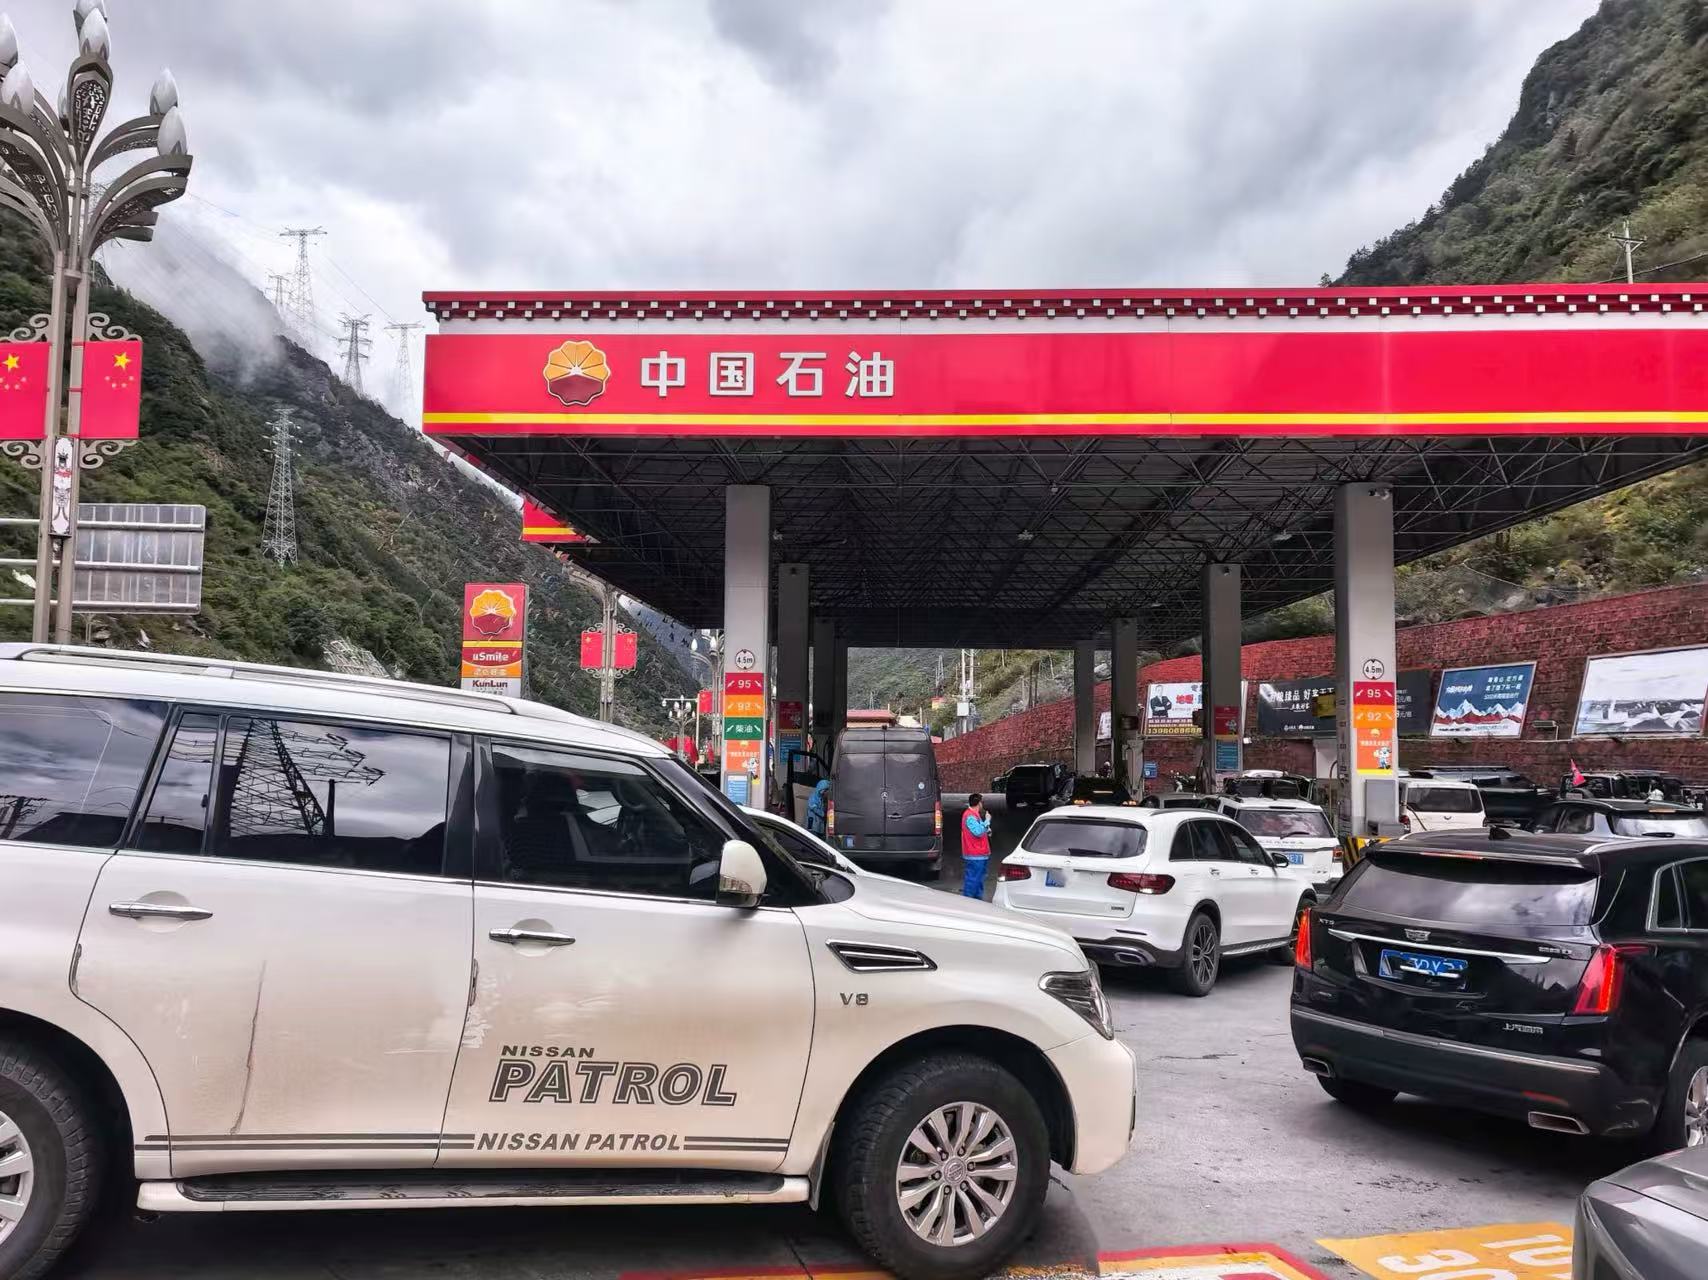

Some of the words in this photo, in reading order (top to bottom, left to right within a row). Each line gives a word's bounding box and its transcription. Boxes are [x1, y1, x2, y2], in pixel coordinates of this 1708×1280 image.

[640, 350, 895, 398] 中国石油
[472, 651, 509, 662] uSmile
[1365, 666, 1382, 674] 4.5m
[472, 679, 508, 688] KunLun
[737, 680, 752, 688] 95
[1367, 689, 1381, 698] 95
[737, 702, 751, 711] 92
[1367, 711, 1382, 720] 92
[735, 724, 753, 733] 柴油
[840, 992, 869, 1006] V8
[500, 1045, 595, 1059] NISSAN
[488, 1059, 738, 1107] PATROL
[477, 1132, 581, 1151] NISSAN
[583, 1133, 681, 1152] PATROL
